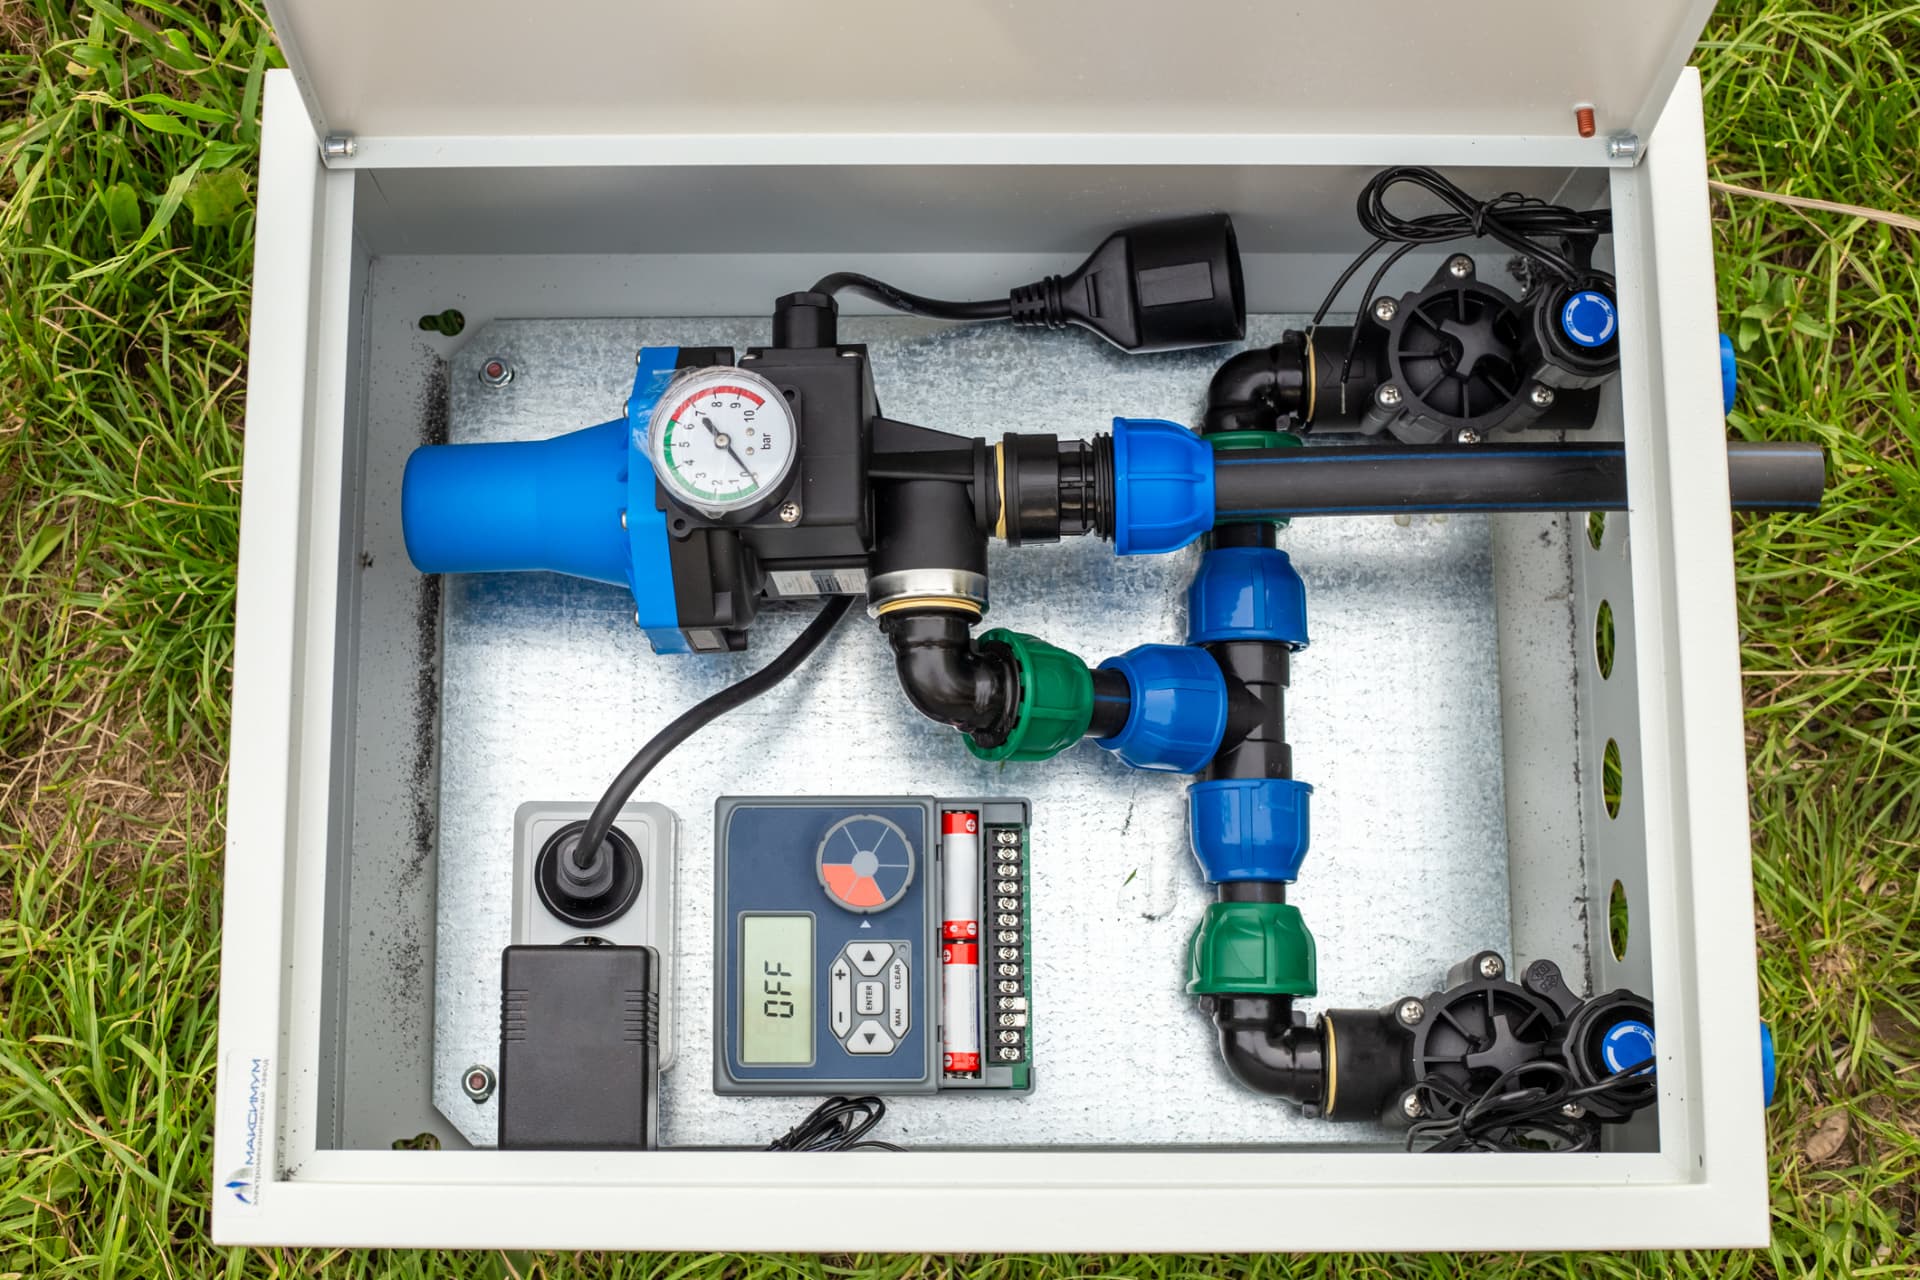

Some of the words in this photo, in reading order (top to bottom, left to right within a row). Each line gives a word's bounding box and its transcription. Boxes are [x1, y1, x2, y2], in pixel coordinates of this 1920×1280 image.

[744, 410, 755, 422] 10
[761, 433, 771, 450] bar
[764, 960, 794, 1019] OFF
[245, 1058, 261, 1165] МАКСИМУМ
